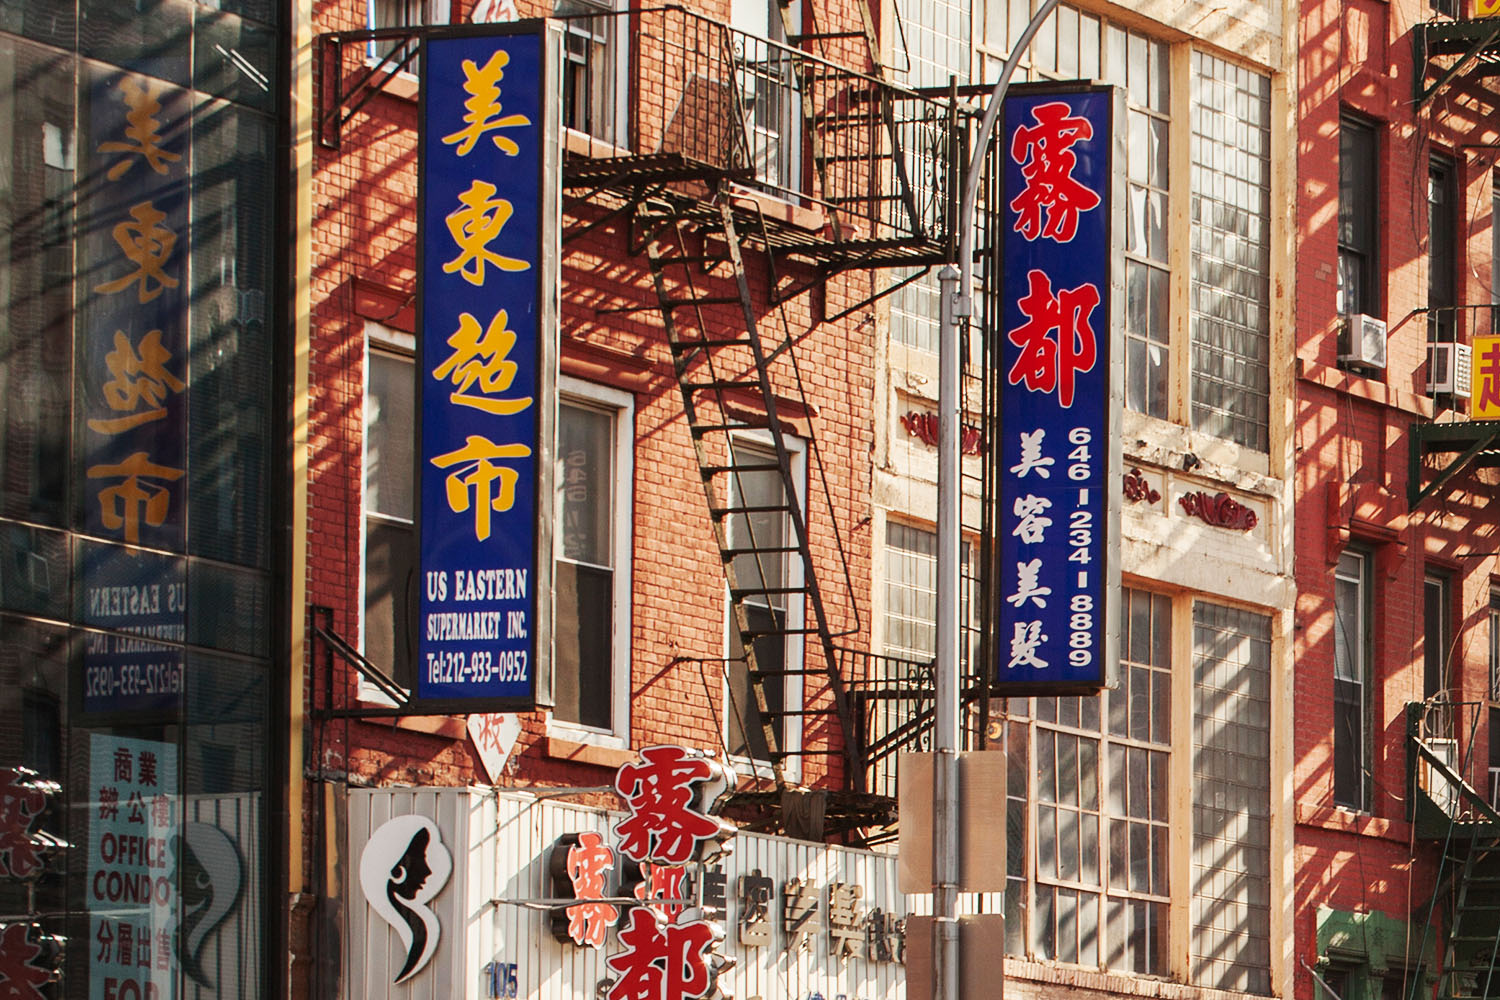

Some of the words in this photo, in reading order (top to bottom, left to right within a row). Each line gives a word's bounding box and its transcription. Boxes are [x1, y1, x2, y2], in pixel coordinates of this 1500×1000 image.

[1009, 101, 1101, 408] 霧都
[430, 49, 533, 542] 美東超市
[1006, 428, 1054, 668] 美容美髮
[426, 570, 447, 602] US
[454, 569, 527, 600] EASTERN
[426, 610, 500, 641] SUPERMARKET
[507, 608, 527, 639] INC.
[426, 649, 528, 685] Tel:212-933-0952
[113, 748, 157, 787] 商業
[100, 832, 166, 869] OFFICE
[93, 870, 170, 907] CONDO
[486, 961, 518, 999] 105
